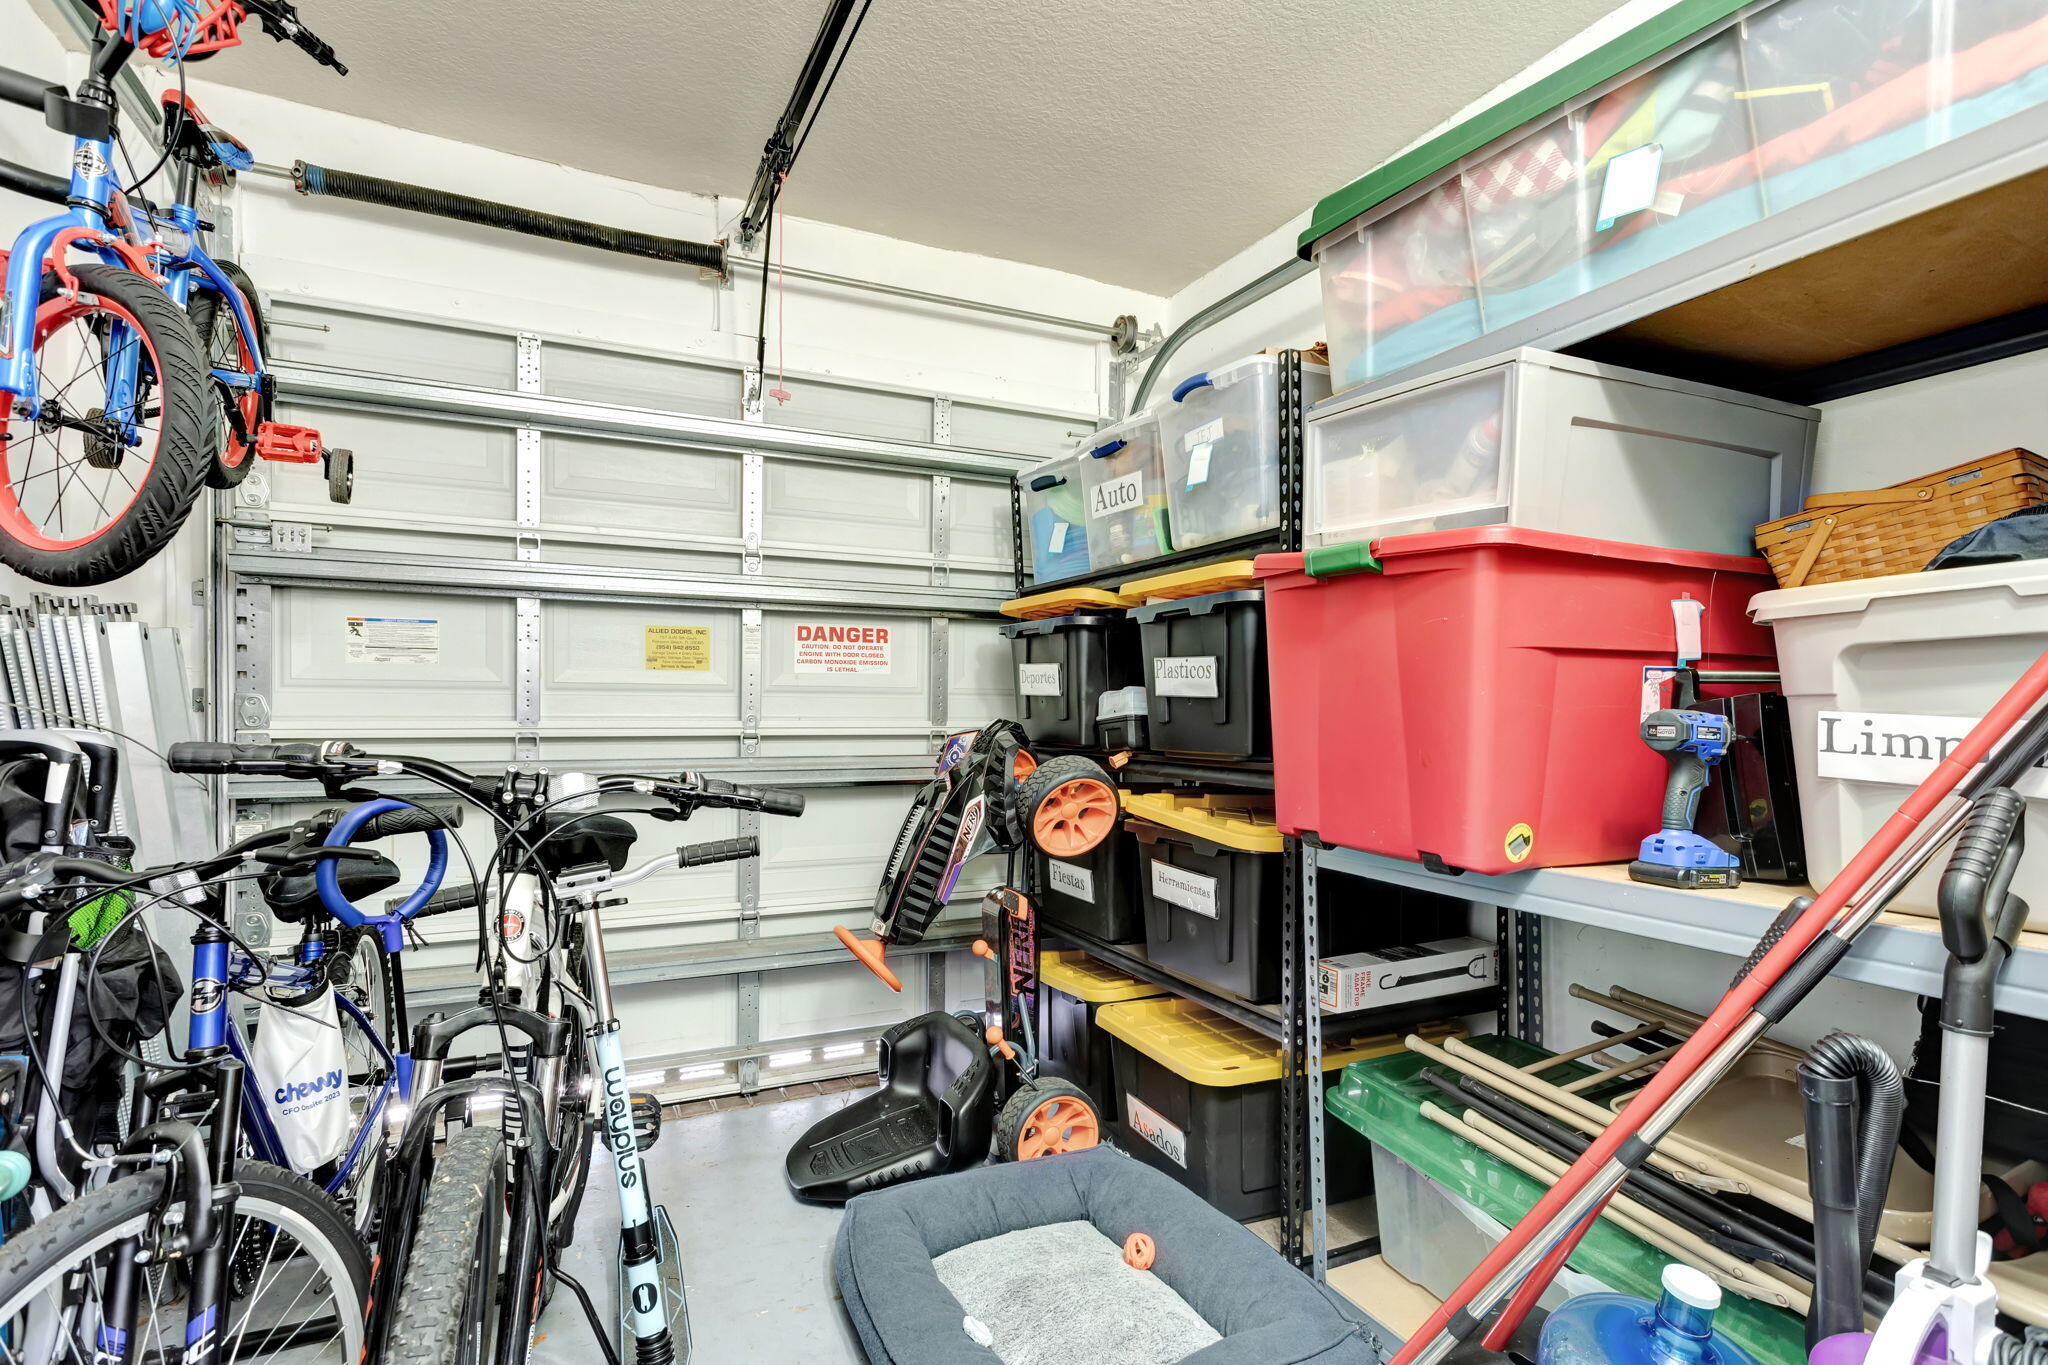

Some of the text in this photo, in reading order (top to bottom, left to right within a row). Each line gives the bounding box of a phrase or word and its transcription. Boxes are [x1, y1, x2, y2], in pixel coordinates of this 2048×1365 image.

[1094, 481, 1137, 512] Auto
[797, 626, 888, 643] DANGER
[1021, 669, 1056, 688] Deportes
[1155, 659, 1212, 679] Plasticos
[962, 807, 979, 840] NERF
[1052, 863, 1085, 891] Fiestas
[1158, 870, 1211, 899] Herramientas
[275, 1069, 342, 1104] chewy
[282, 1091, 341, 1116] CFO Onsite 2023
[604, 1066, 637, 1189] wayplus
[1134, 1111, 1180, 1161] Asados
